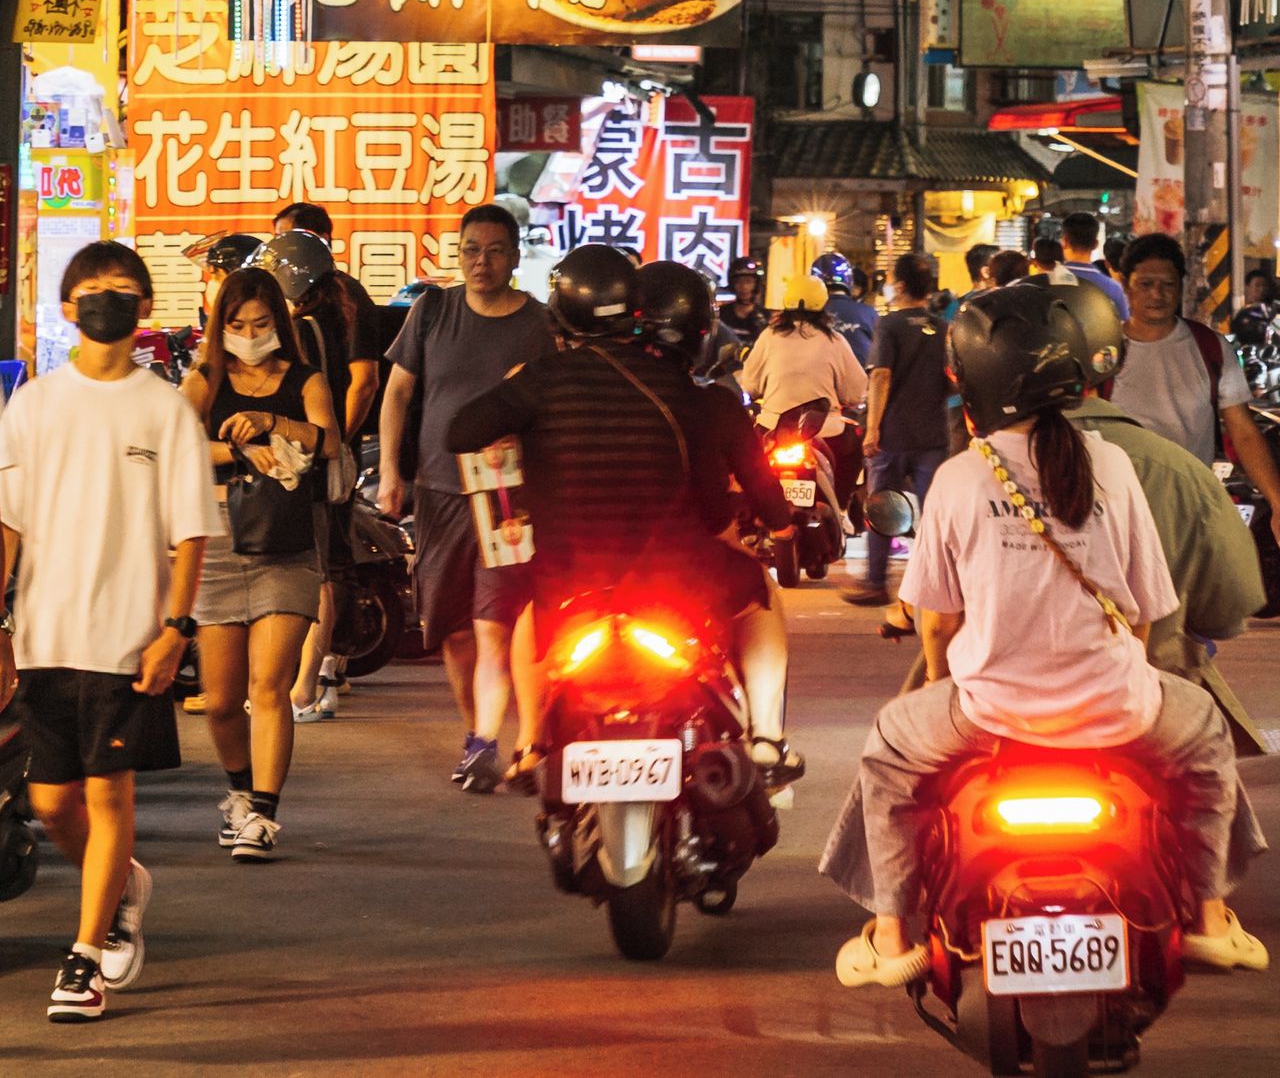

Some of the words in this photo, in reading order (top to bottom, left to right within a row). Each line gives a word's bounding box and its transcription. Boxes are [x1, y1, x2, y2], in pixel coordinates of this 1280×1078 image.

[134, 109, 489, 208] 花生紅豆湯
[991, 935, 1121, 978] EQQ-5689
